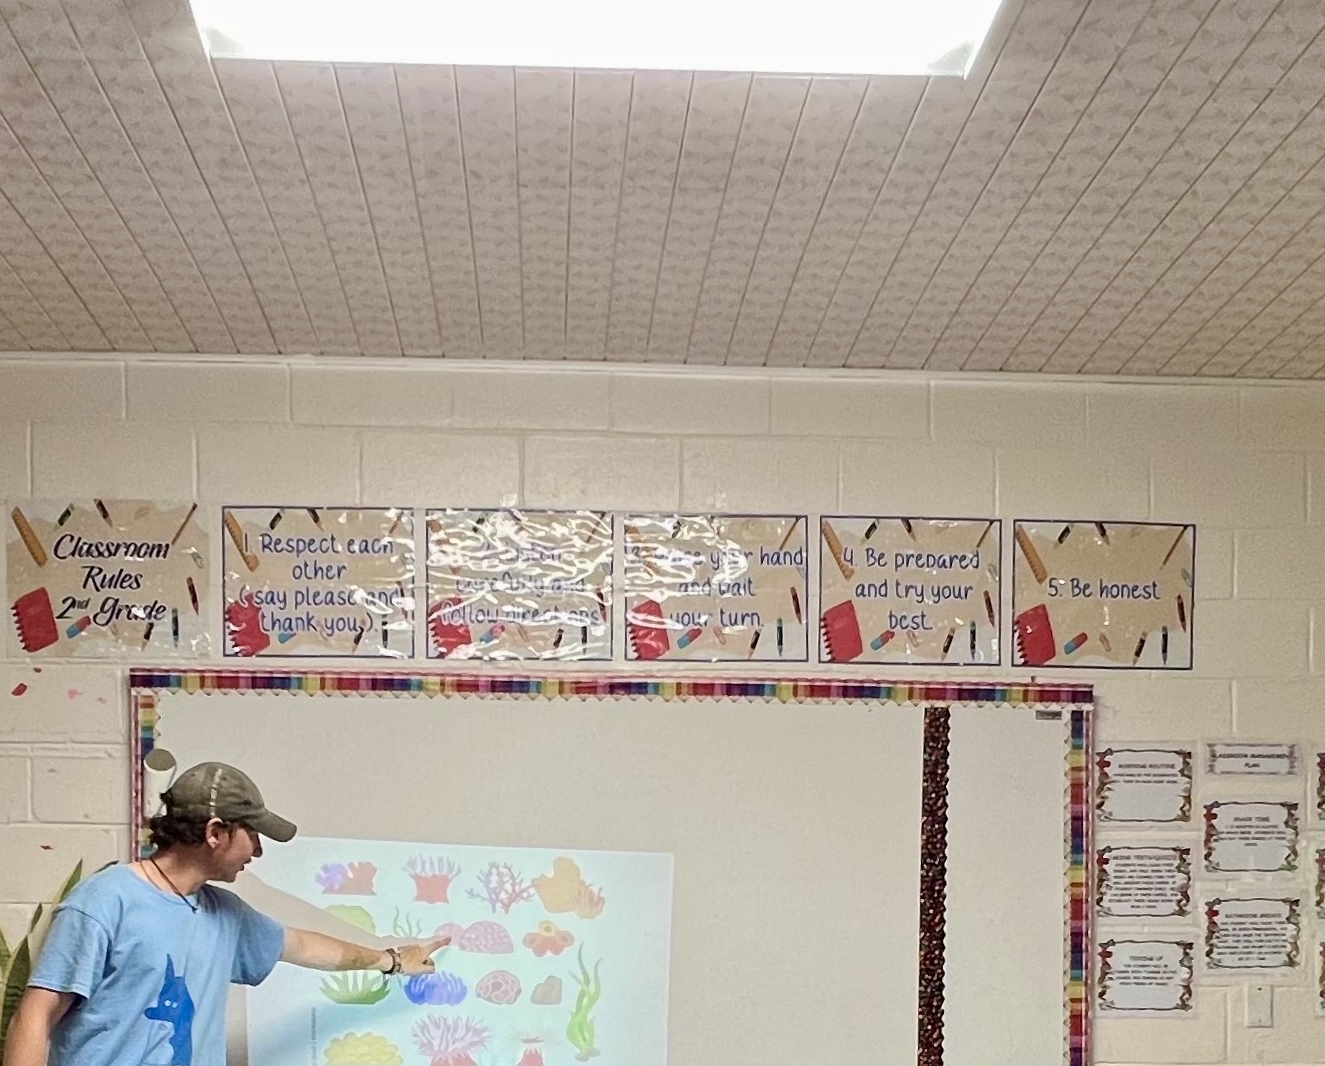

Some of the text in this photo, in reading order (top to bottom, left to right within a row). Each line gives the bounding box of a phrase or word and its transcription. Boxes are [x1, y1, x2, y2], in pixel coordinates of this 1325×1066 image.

[53, 533, 170, 559] Classroom
[260, 533, 340, 557] Respect
[347, 536, 394, 554] each
[292, 560, 348, 581] other
[711, 551, 754, 571] yr
[760, 546, 804, 566] hand
[843, 547, 980, 572] 4. Be prepared
[80, 565, 144, 592] Rules
[678, 577, 757, 597] and wait
[1047, 577, 1161, 600] 5. Be honest
[294, 587, 357, 611] please
[855, 578, 974, 605] and try your
[55, 596, 91, 620] 2nd
[440, 600, 499, 625] follow
[260, 611, 318, 633] thank
[669, 612, 714, 629] your
